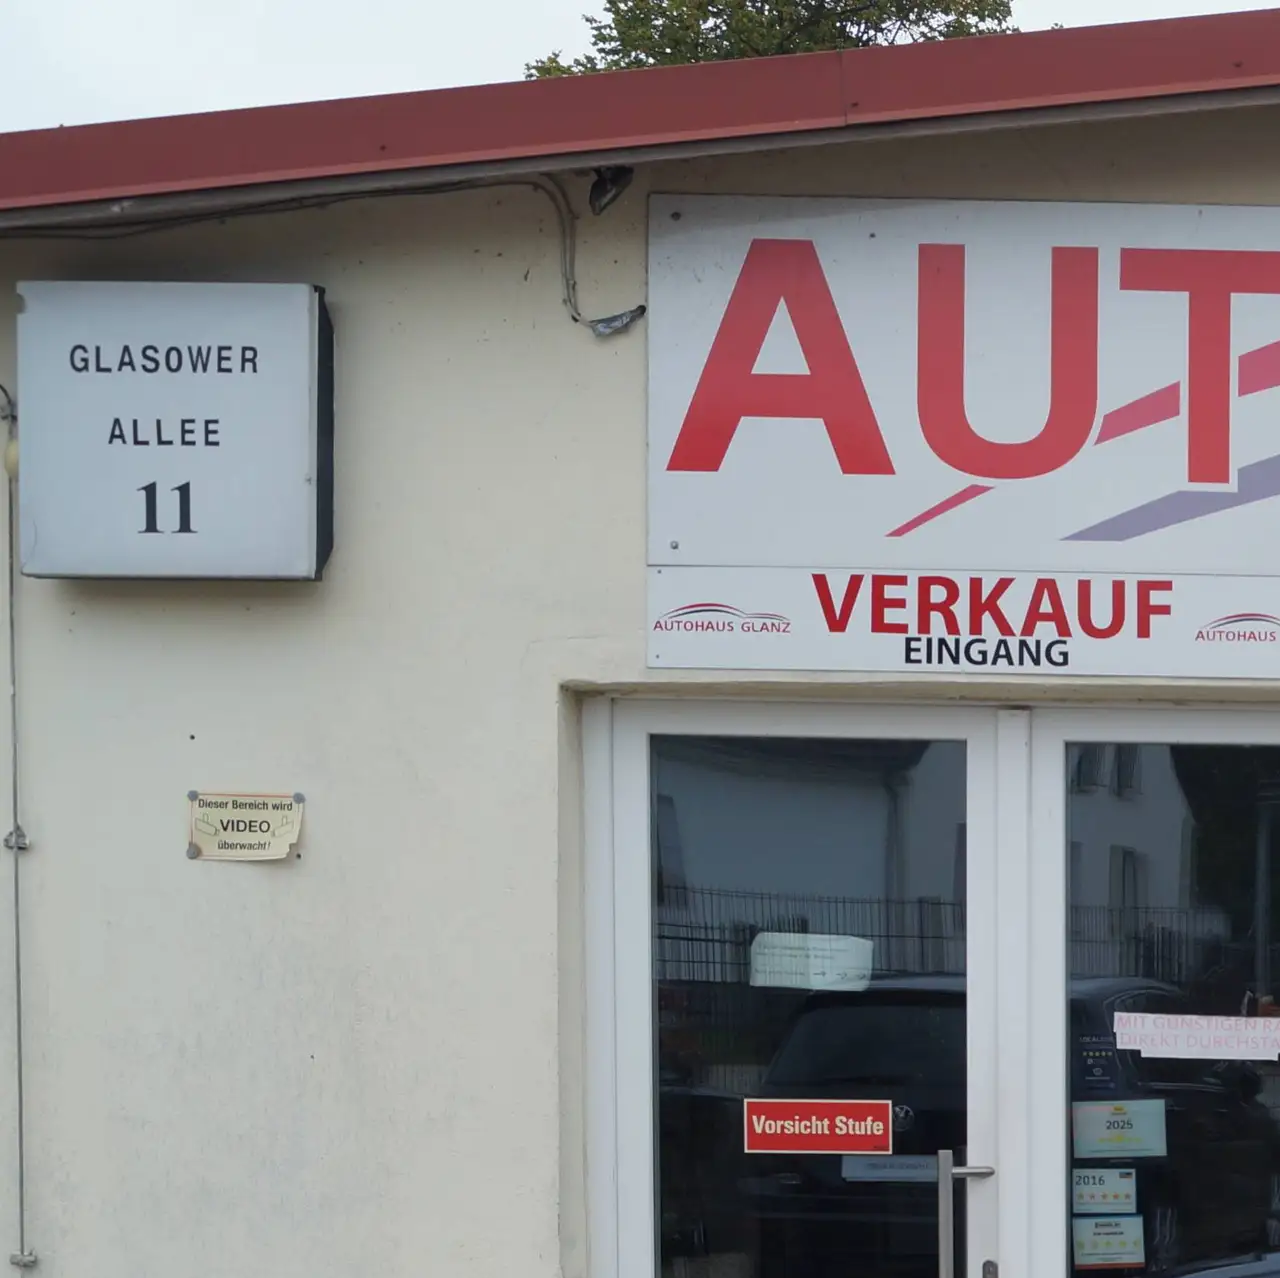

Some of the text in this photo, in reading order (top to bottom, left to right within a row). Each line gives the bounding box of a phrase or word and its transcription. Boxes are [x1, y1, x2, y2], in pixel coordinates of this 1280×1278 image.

[69, 344, 259, 374] GLASOWER
[107, 417, 221, 447] ALLEE
[136, 480, 198, 534] 11
[811, 572, 1173, 640] VERKAUF
[653, 619, 791, 635] AUTOHAUS GLANZ
[1195, 628, 1277, 644] AUTOHAUS
[904, 636, 1070, 668] EINGANG
[198, 798, 293, 812] Dieser Bereich wird
[219, 818, 271, 834] VIDEO
[1116, 1015, 1147, 1029] MIT
[751, 1114, 884, 1136] Vorsicht Stufe
[1105, 1119, 1134, 1131] 2025
[1075, 1174, 1106, 1187] 2016
